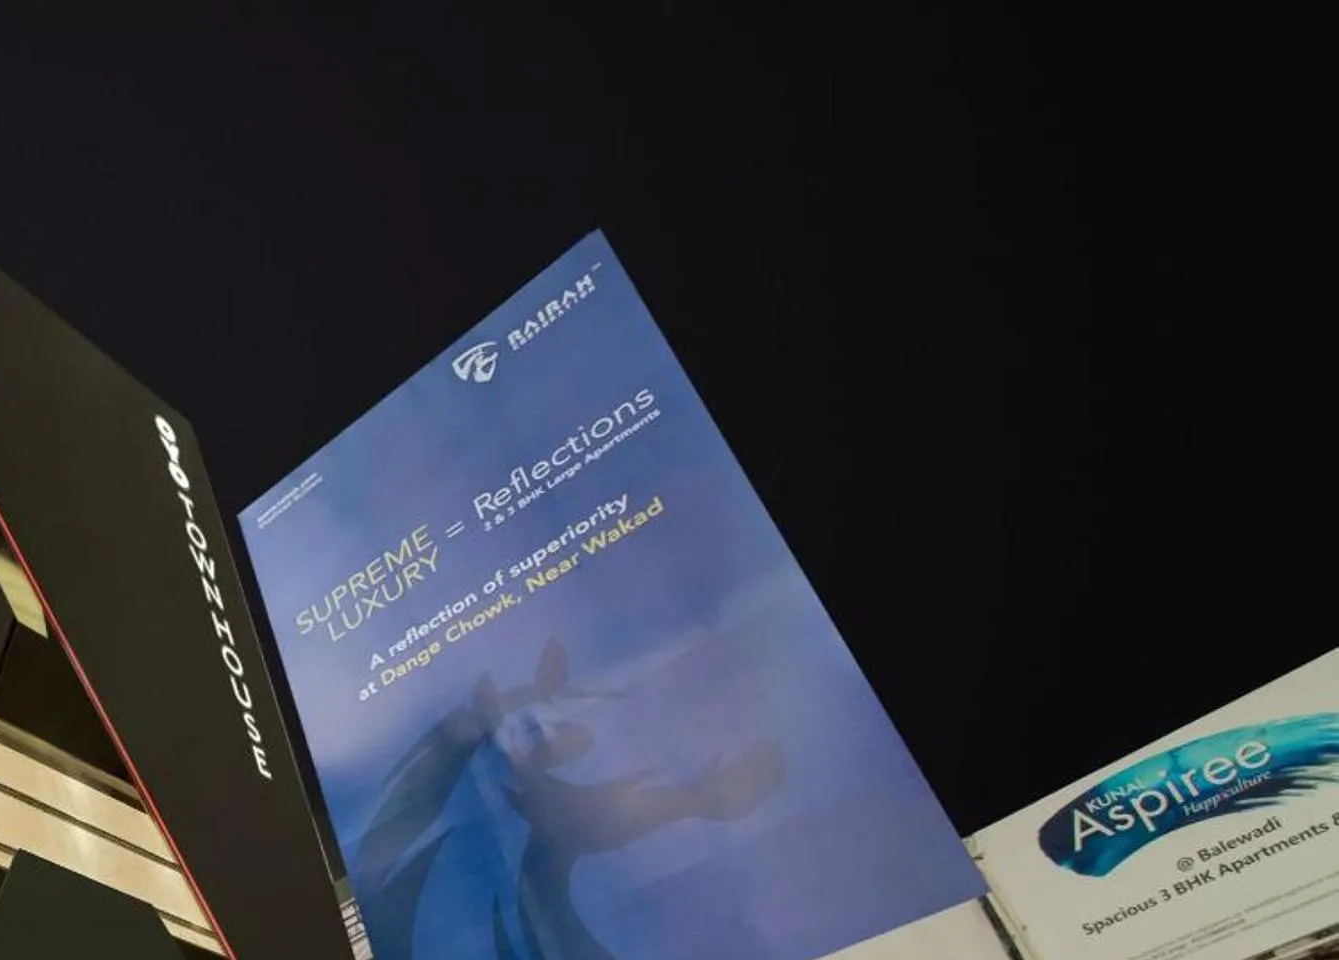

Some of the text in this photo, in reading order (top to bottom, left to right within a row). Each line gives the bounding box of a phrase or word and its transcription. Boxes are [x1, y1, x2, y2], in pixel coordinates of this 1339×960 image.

[296, 523, 434, 635] SUPREME
[473, 388, 654, 520] Reflections
[483, 520, 493, 532] 2
[494, 513, 505, 525] &
[517, 486, 546, 509] BHK
[546, 461, 583, 489] Large
[584, 408, 661, 465] Apartments
[327, 546, 438, 642] LUXURY
[359, 496, 665, 701] at Dange Chowk, Near Wakad
[370, 493, 628, 671] A reflection of superiority
[1073, 739, 1272, 852] Aspiree
[1085, 777, 1148, 814] KUNAL
[1176, 814, 1283, 873] @ Balewadi
[1081, 897, 1158, 938] Spacious
[1159, 888, 1172, 902] 3
[1172, 869, 1216, 897] BHK
[1218, 817, 1330, 877] Apartments
